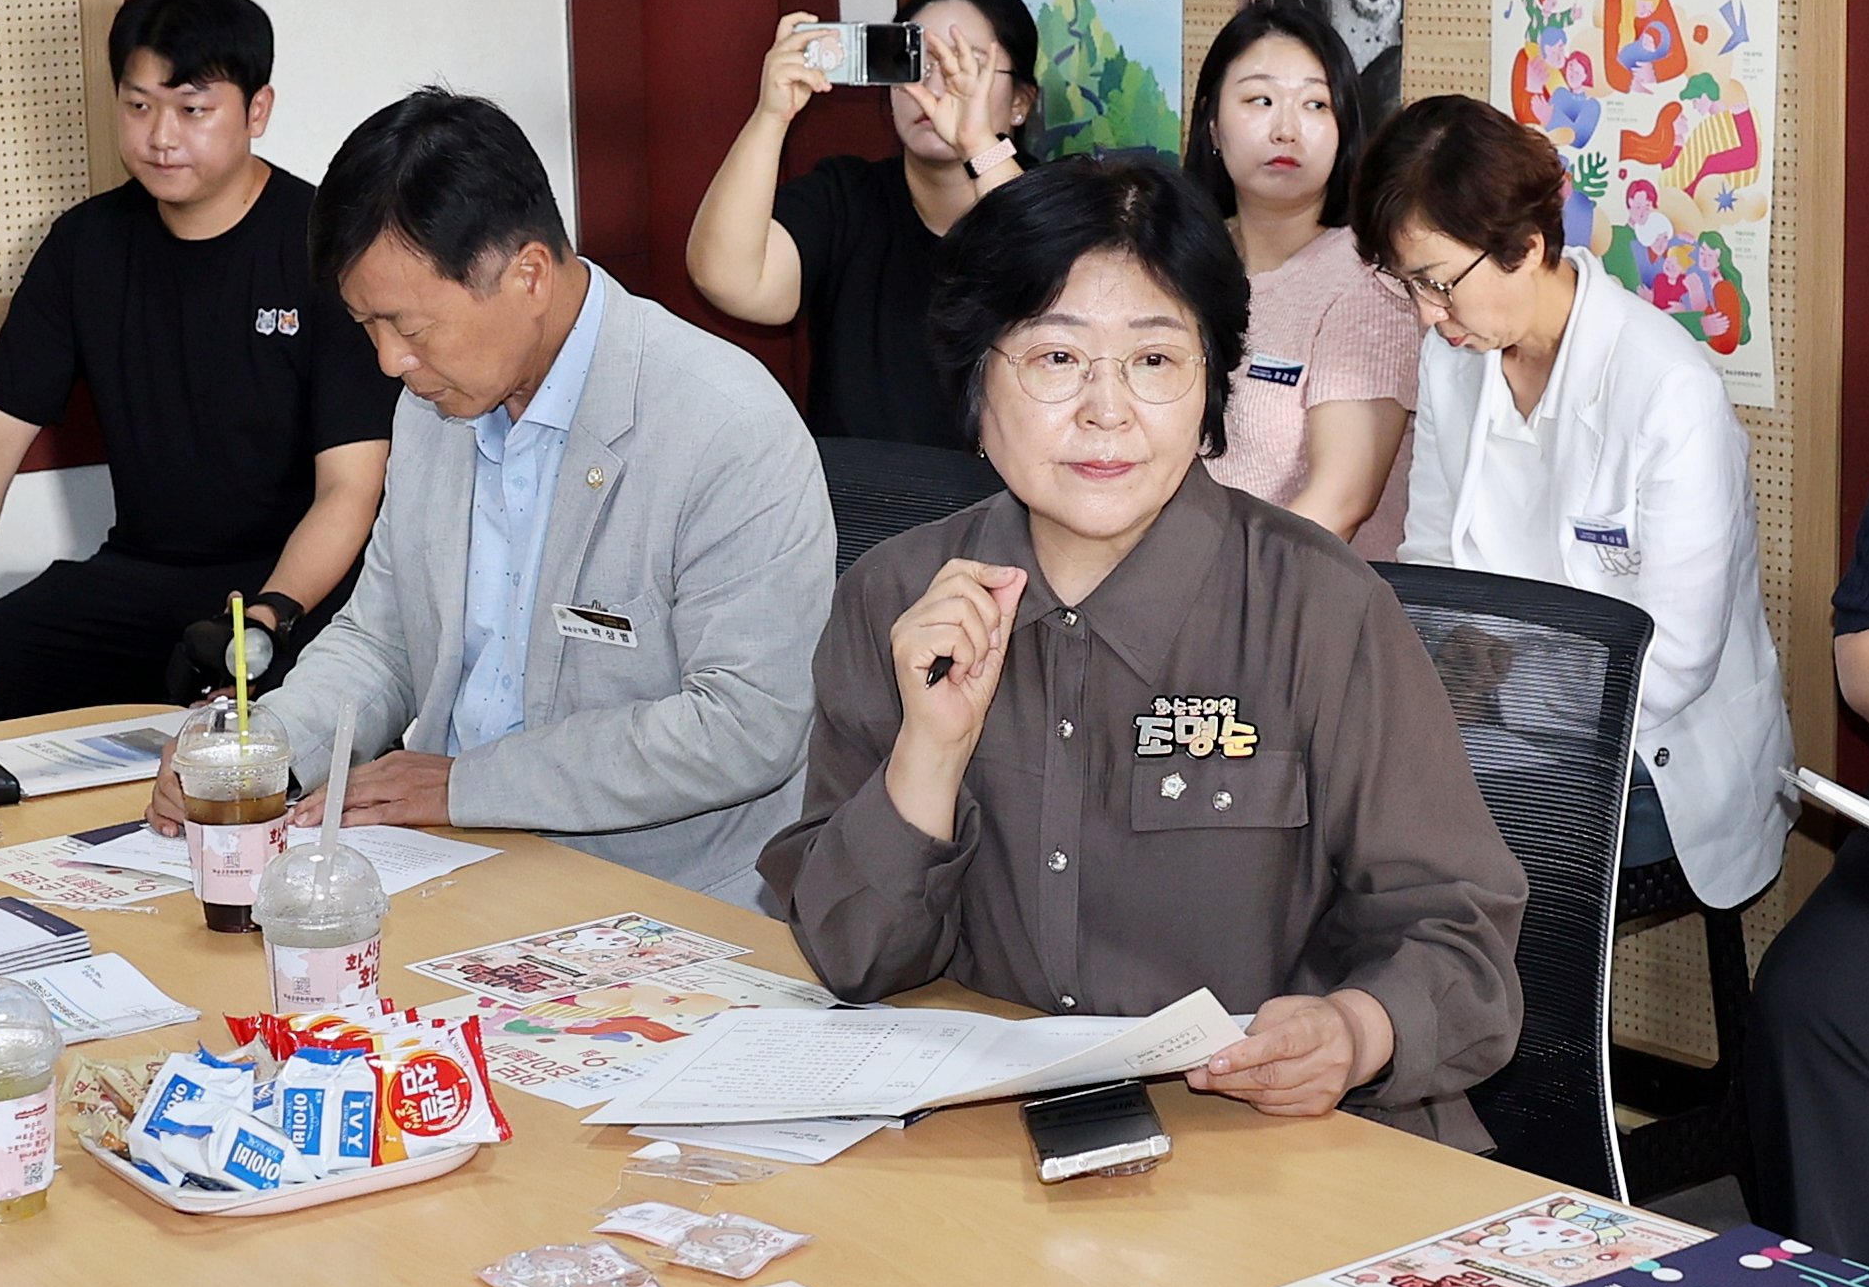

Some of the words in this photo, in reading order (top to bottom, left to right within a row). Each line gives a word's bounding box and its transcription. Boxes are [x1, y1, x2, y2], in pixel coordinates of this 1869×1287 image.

[1153, 697, 1237, 716] 화순군의원
[1135, 715, 1259, 757] 조명순
[348, 1100, 364, 1153] IVY
[232, 1141, 281, 1181] 아이비
